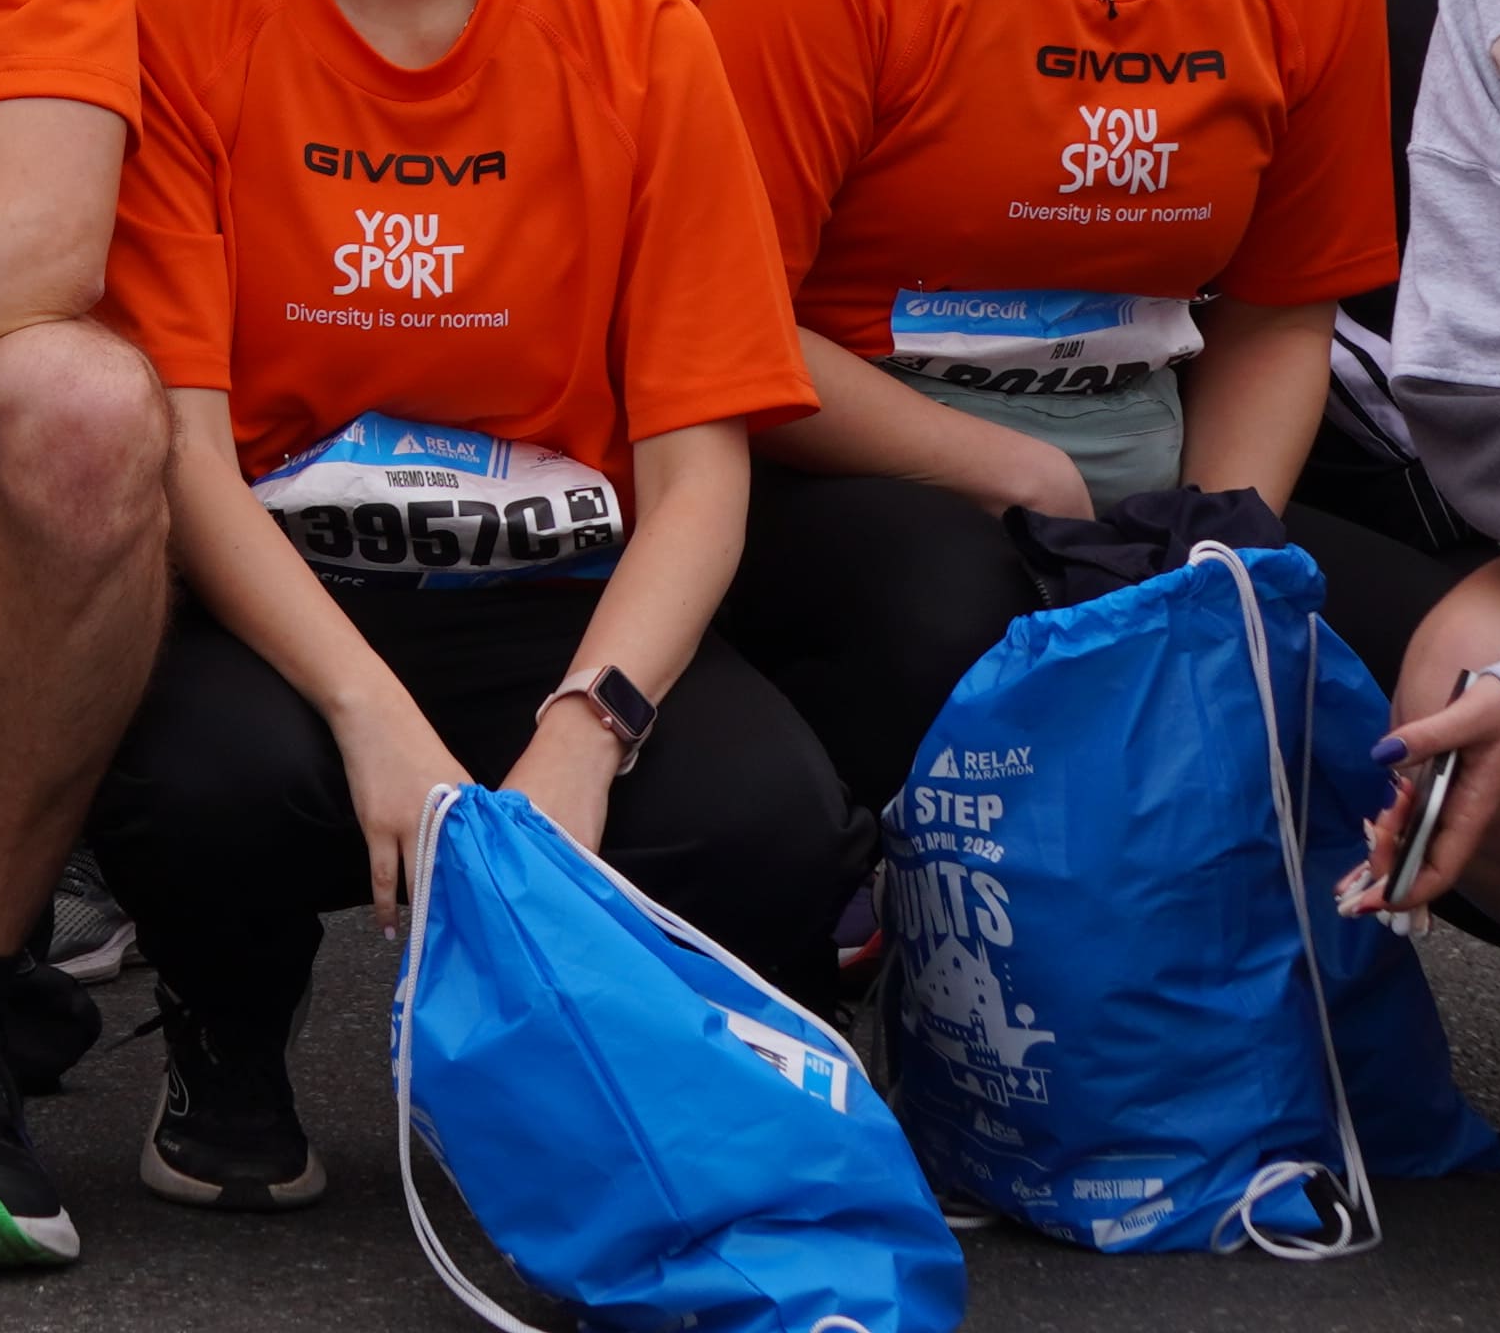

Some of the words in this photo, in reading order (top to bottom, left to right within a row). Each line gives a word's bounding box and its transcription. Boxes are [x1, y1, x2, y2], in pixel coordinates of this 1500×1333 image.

[1037, 45, 1227, 84] GIVOVA
[1078, 105, 1158, 143] YOU
[304, 142, 505, 185] GIVOVA
[1058, 142, 1179, 195] SPORT
[354, 209, 439, 247] YOU
[1008, 201, 1091, 225] Diversity
[1095, 204, 1111, 221] is
[1115, 207, 1148, 222] our
[1151, 202, 1212, 222] normal
[332, 244, 464, 299] SPORT
[286, 302, 374, 330] Diversity
[379, 308, 395, 327] is
[400, 313, 435, 328] our
[440, 309, 509, 328] normal
[931, 298, 1028, 320] UniCredit
[425, 436, 476, 456] RELAY
[385, 470, 424, 487] THERMO
[426, 472, 459, 488] EAGLES
[300, 496, 560, 567] 3957C
[964, 746, 1031, 771] RELAY
[964, 763, 1034, 782] MARATHON
[914, 785, 1003, 832] STEP
[926, 832, 958, 853] APRIL
[963, 835, 1005, 864] 2026
